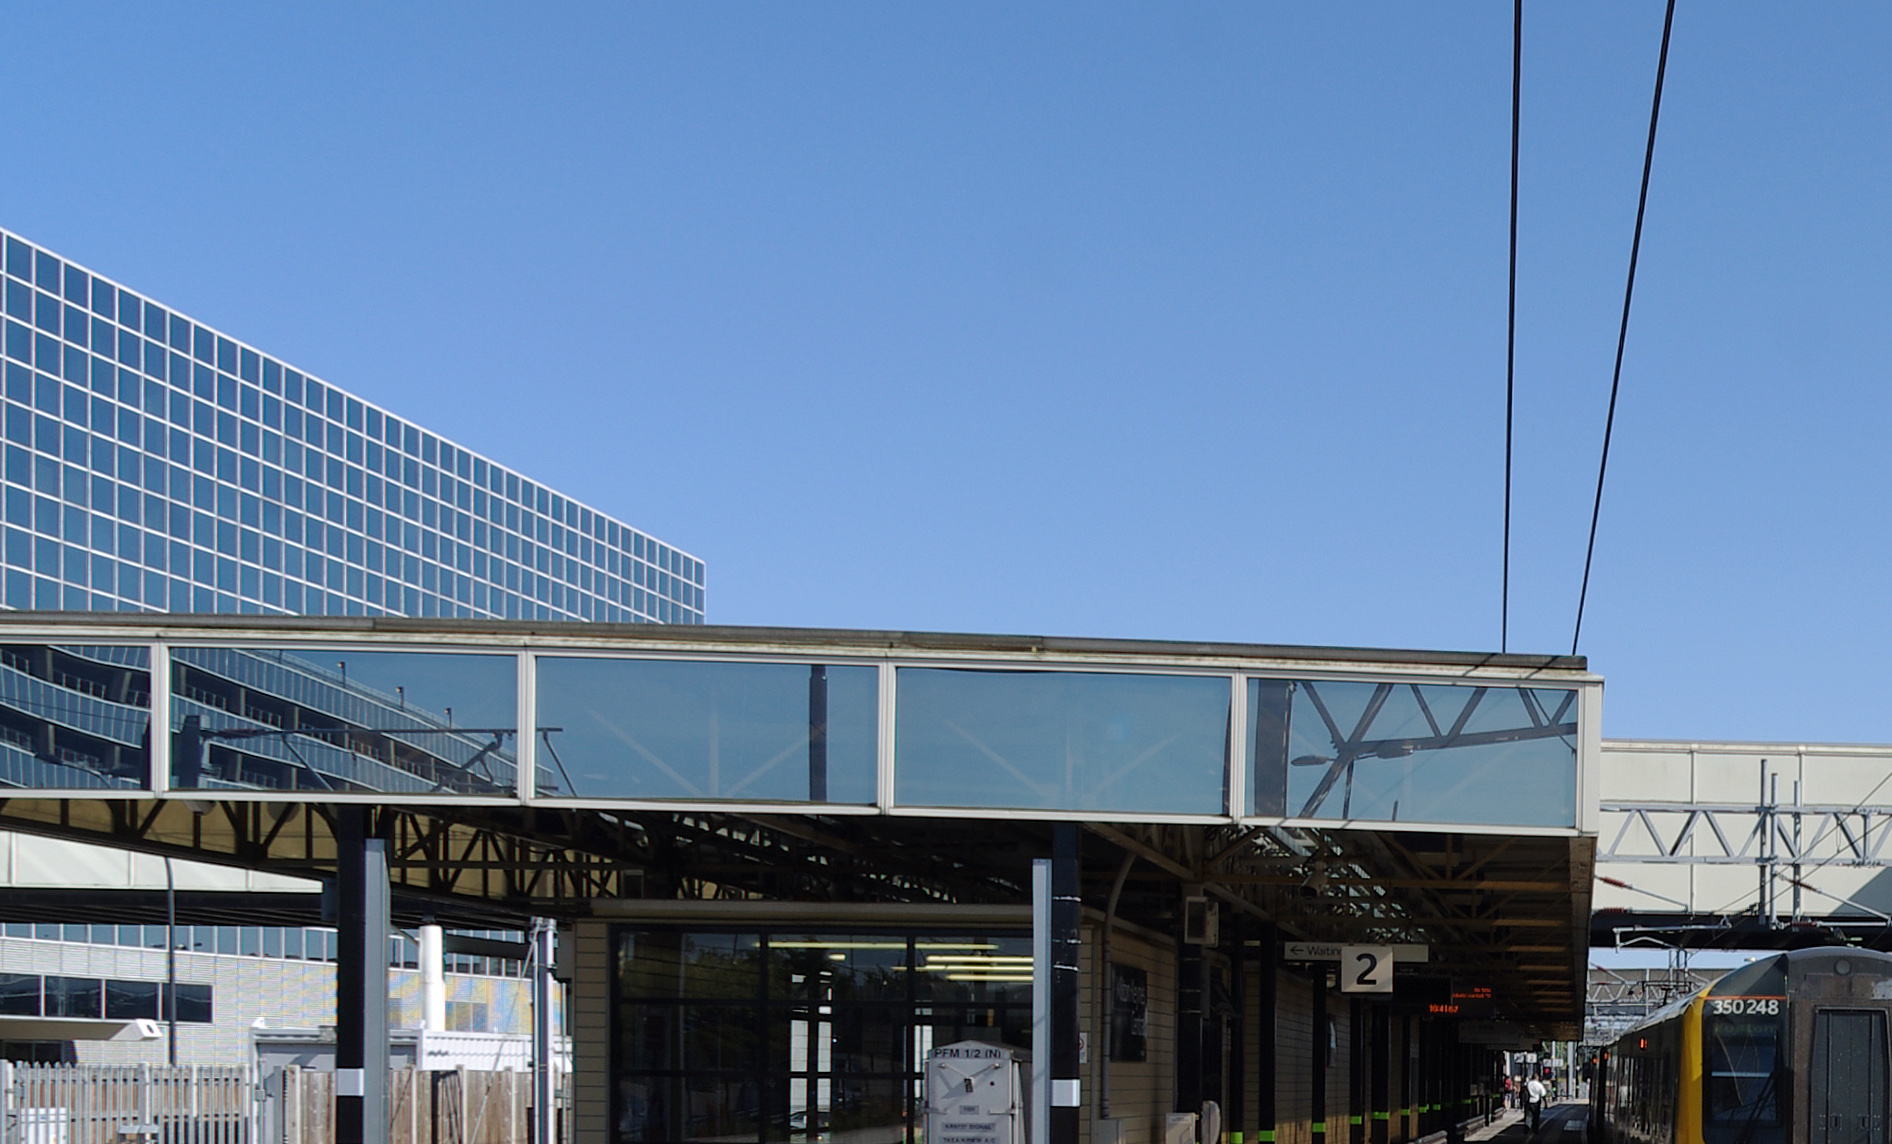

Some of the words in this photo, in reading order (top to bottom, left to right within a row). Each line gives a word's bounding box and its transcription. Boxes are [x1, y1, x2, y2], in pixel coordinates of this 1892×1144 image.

[1307, 945, 1341, 956] Waitin
[1355, 953, 1377, 985] 2
[1712, 999, 1745, 1015] 350
[1746, 999, 1780, 1015] 248
[934, 1048, 960, 1058] PFM
[964, 1048, 981, 1058] 1/2
[985, 1048, 1001, 1059] (N)
